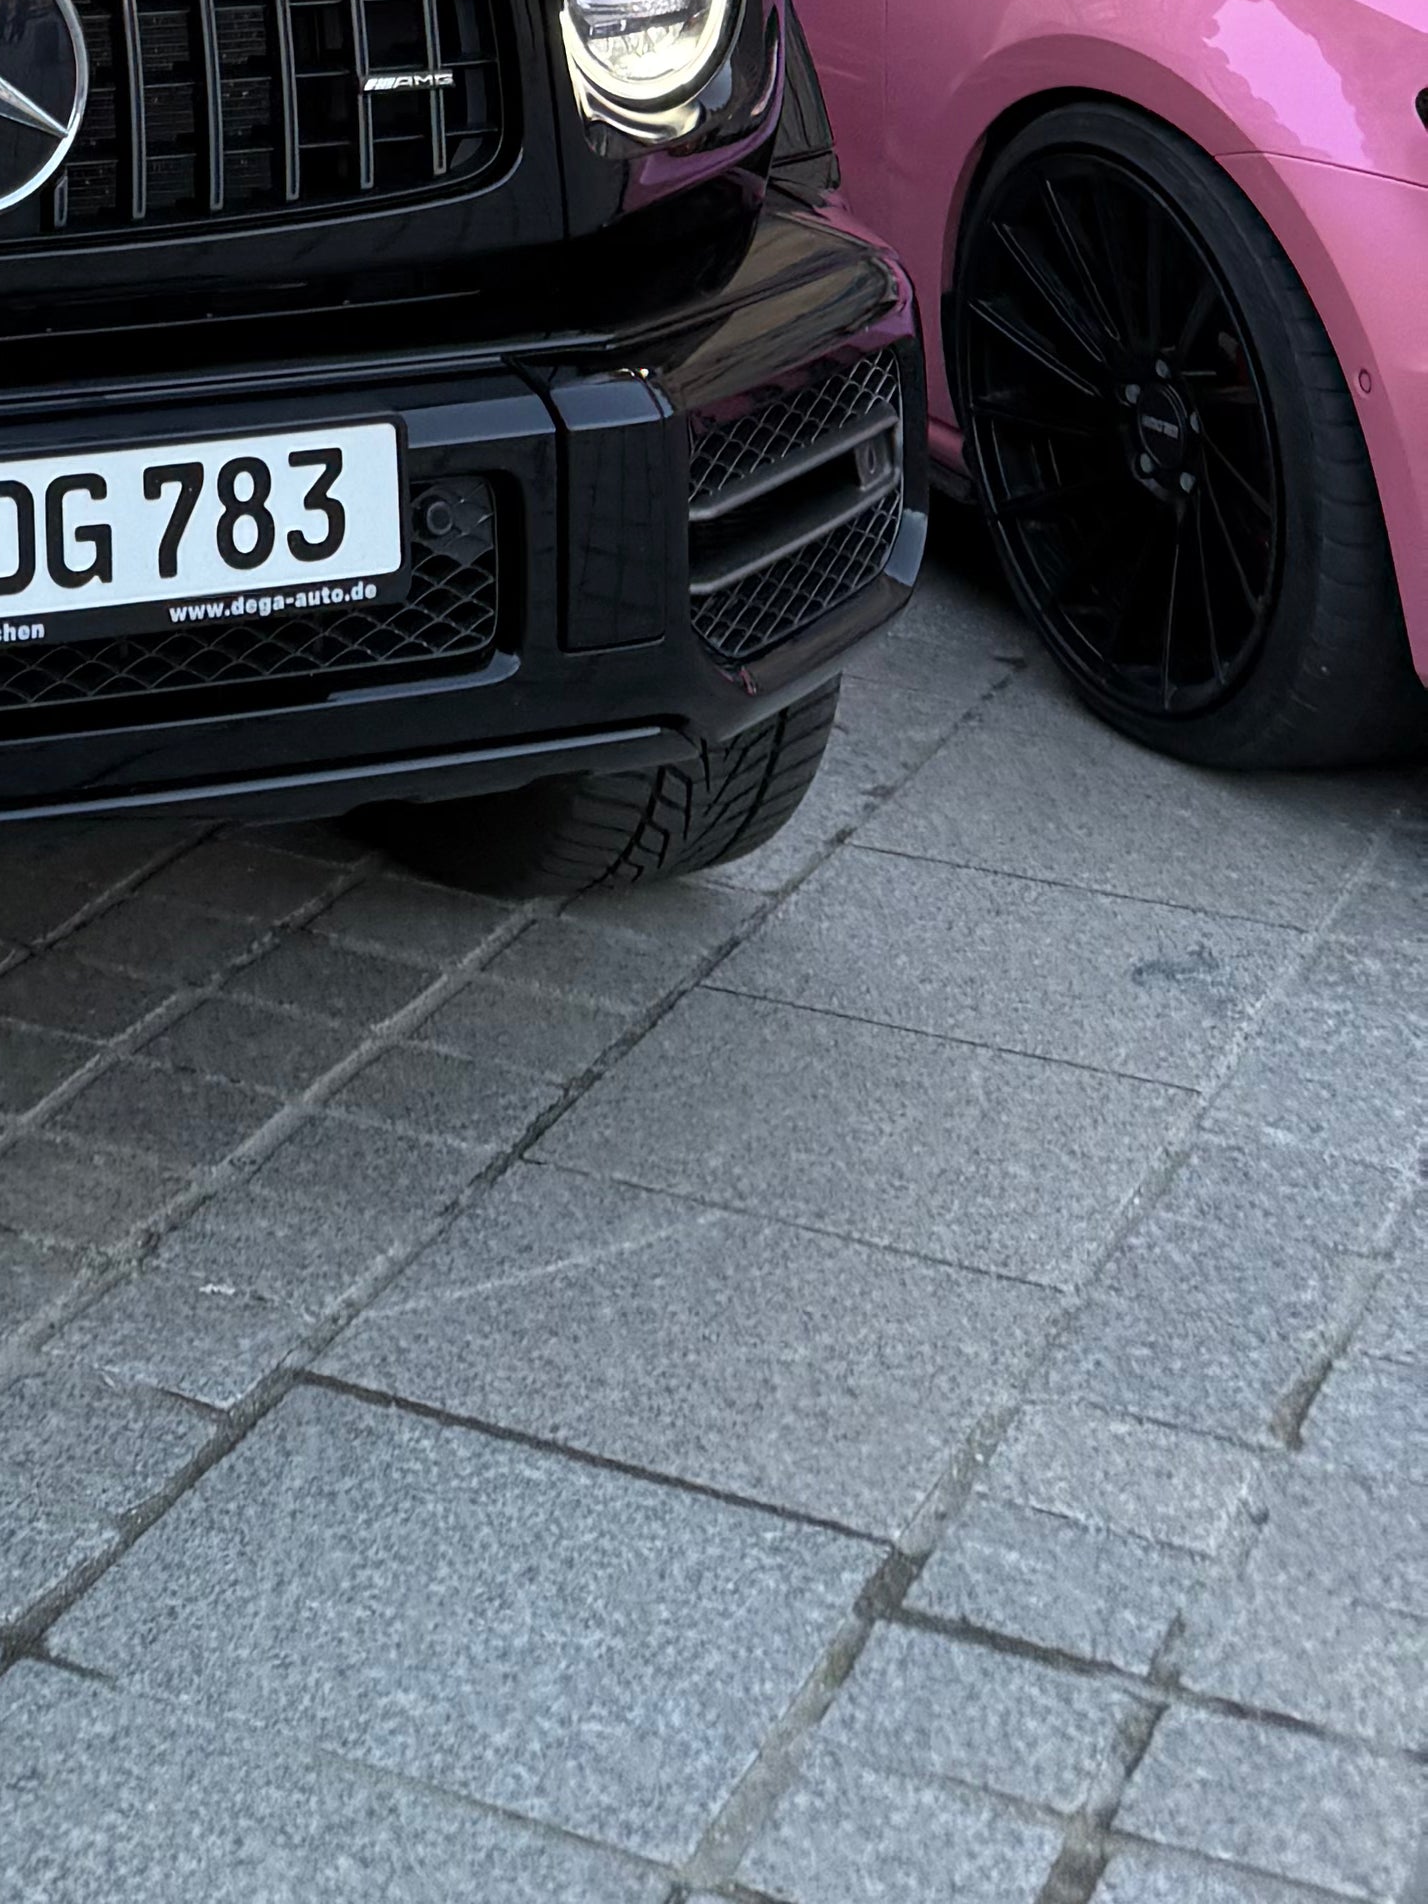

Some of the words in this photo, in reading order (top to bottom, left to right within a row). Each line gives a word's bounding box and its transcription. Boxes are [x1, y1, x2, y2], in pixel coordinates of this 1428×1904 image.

[393, 73, 455, 89] AMG
[142, 446, 346, 579] 783
[169, 580, 378, 623] www.dega-auto.de
